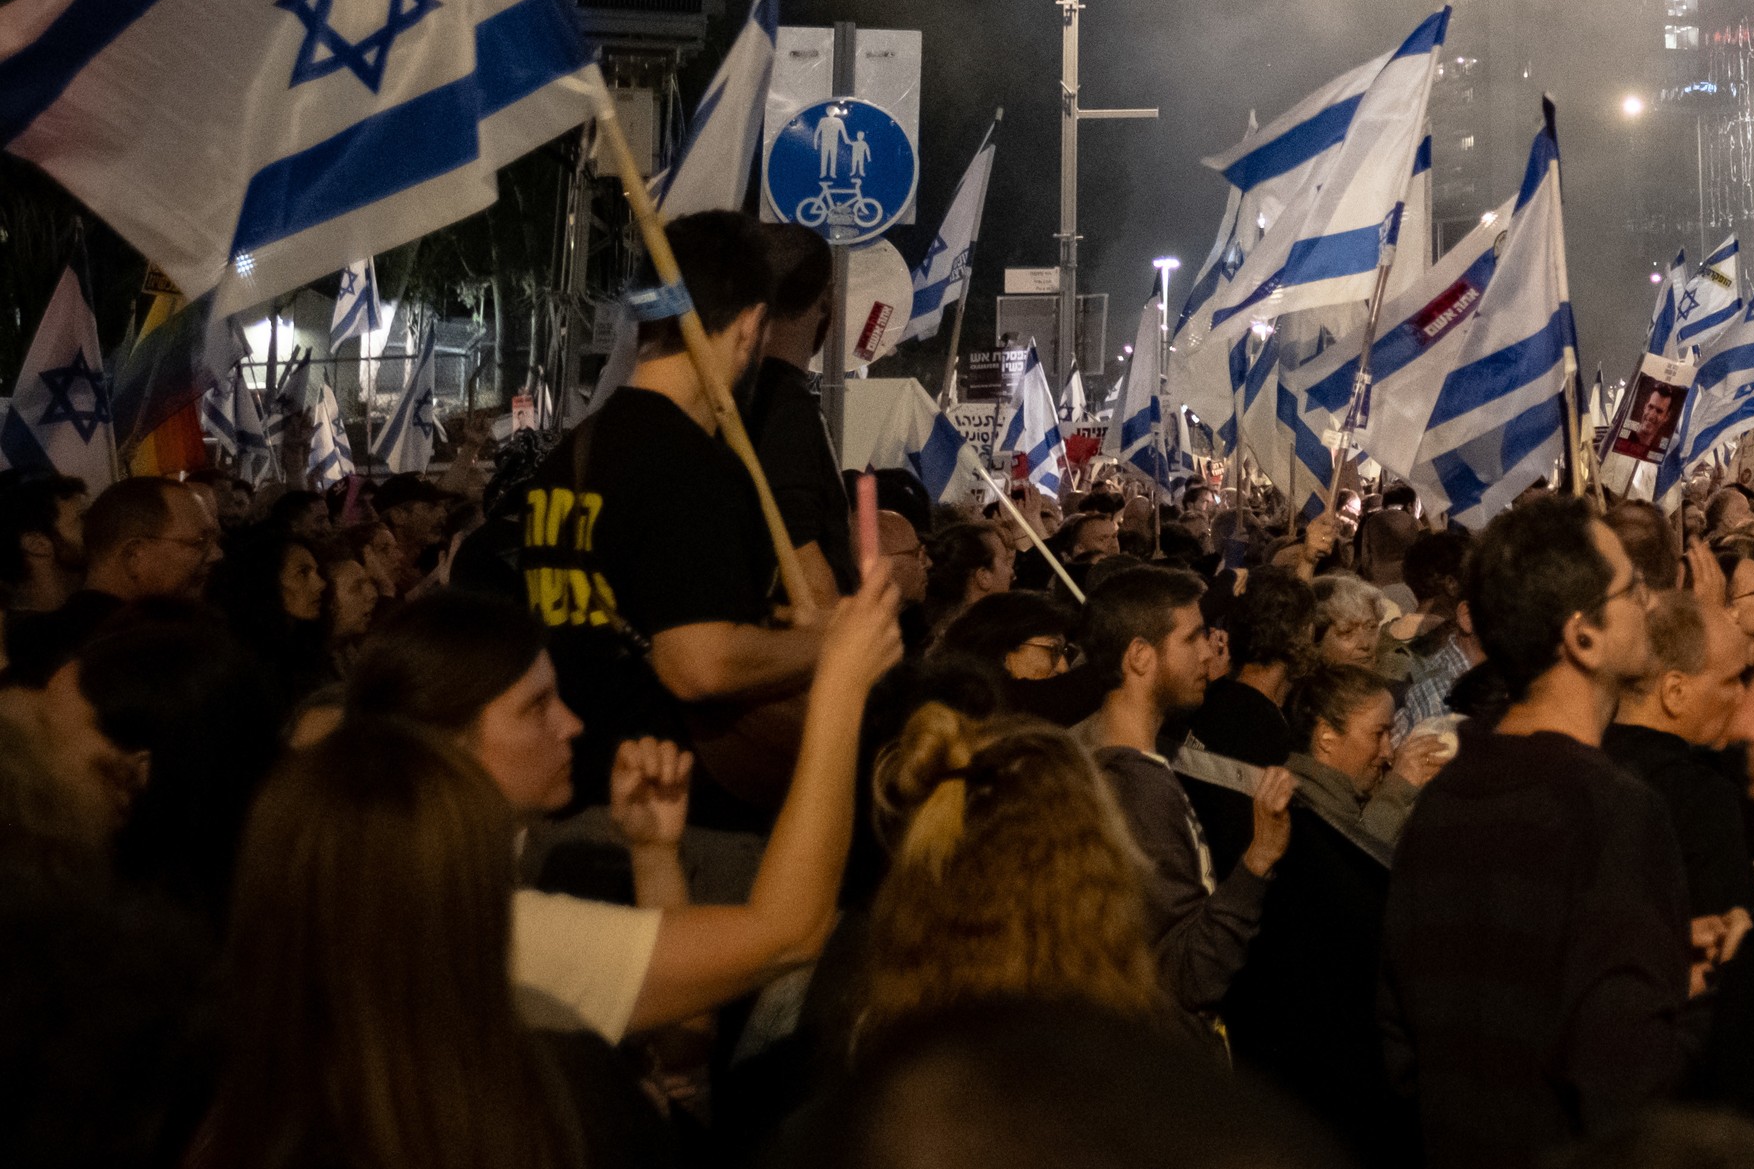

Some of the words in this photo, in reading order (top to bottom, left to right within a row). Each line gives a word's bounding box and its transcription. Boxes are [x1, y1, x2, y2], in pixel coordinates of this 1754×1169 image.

[1454, 287, 1480, 313] אתה
[1423, 307, 1458, 337] אשם
[970, 352, 990, 363] אש
[1002, 362, 1024, 373] כשיו
